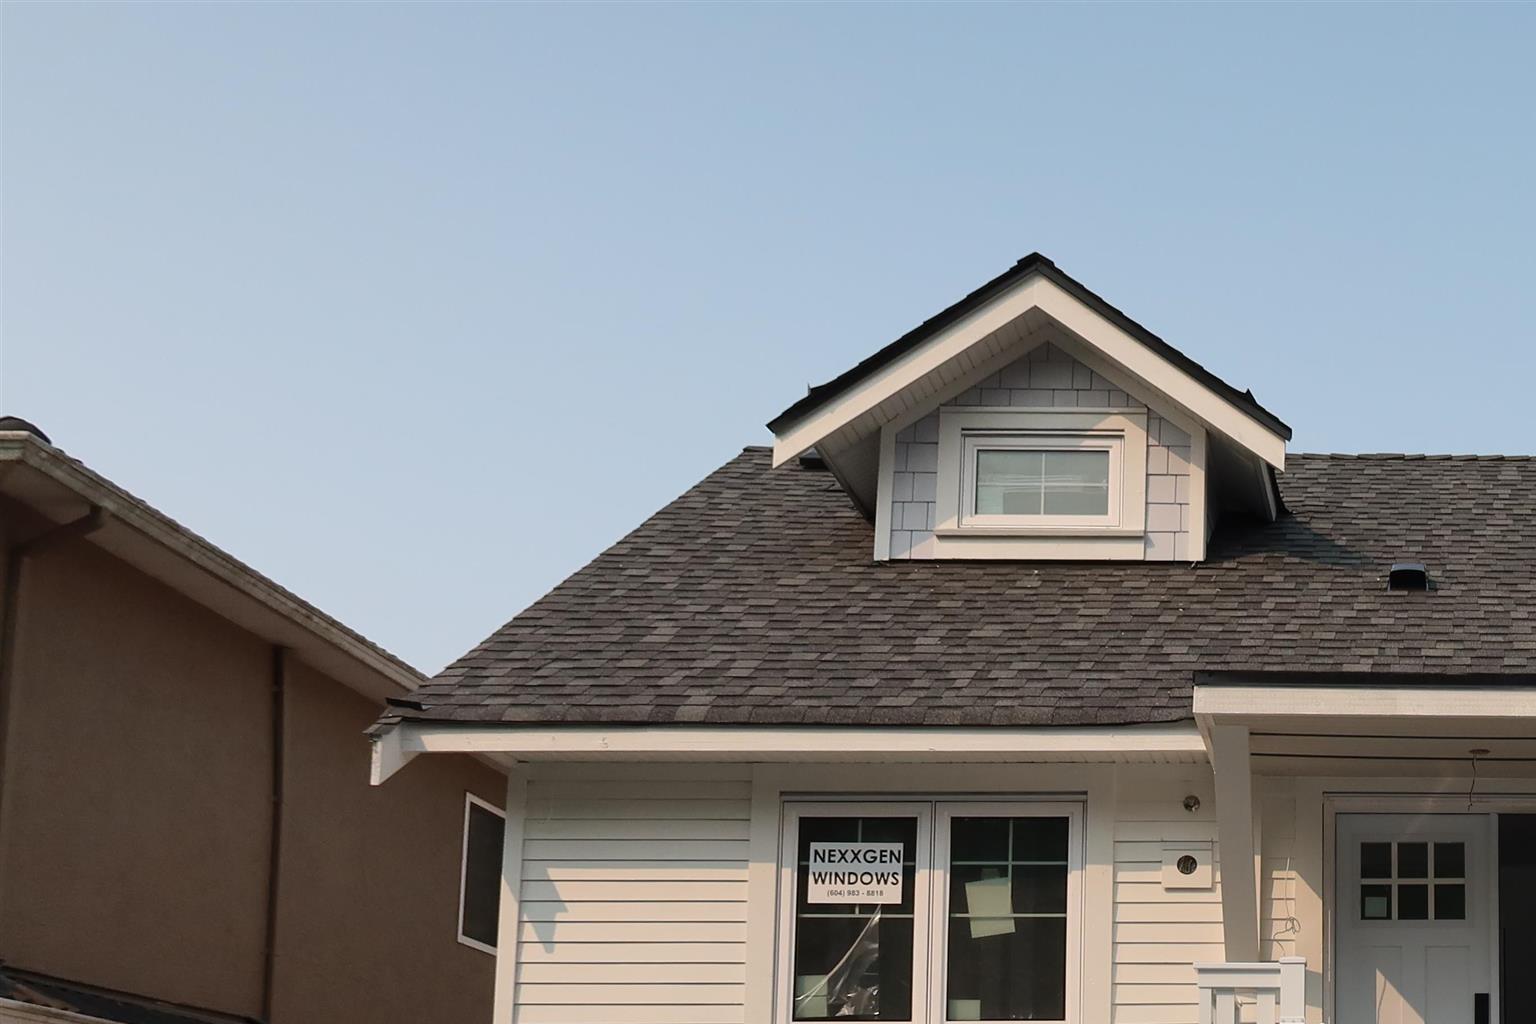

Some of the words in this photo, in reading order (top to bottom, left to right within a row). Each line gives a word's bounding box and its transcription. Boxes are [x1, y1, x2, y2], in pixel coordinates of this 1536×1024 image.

[814, 849, 901, 863] NEXXGEN
[812, 871, 899, 885] WINDOWS
[827, 889, 845, 897] (604)
